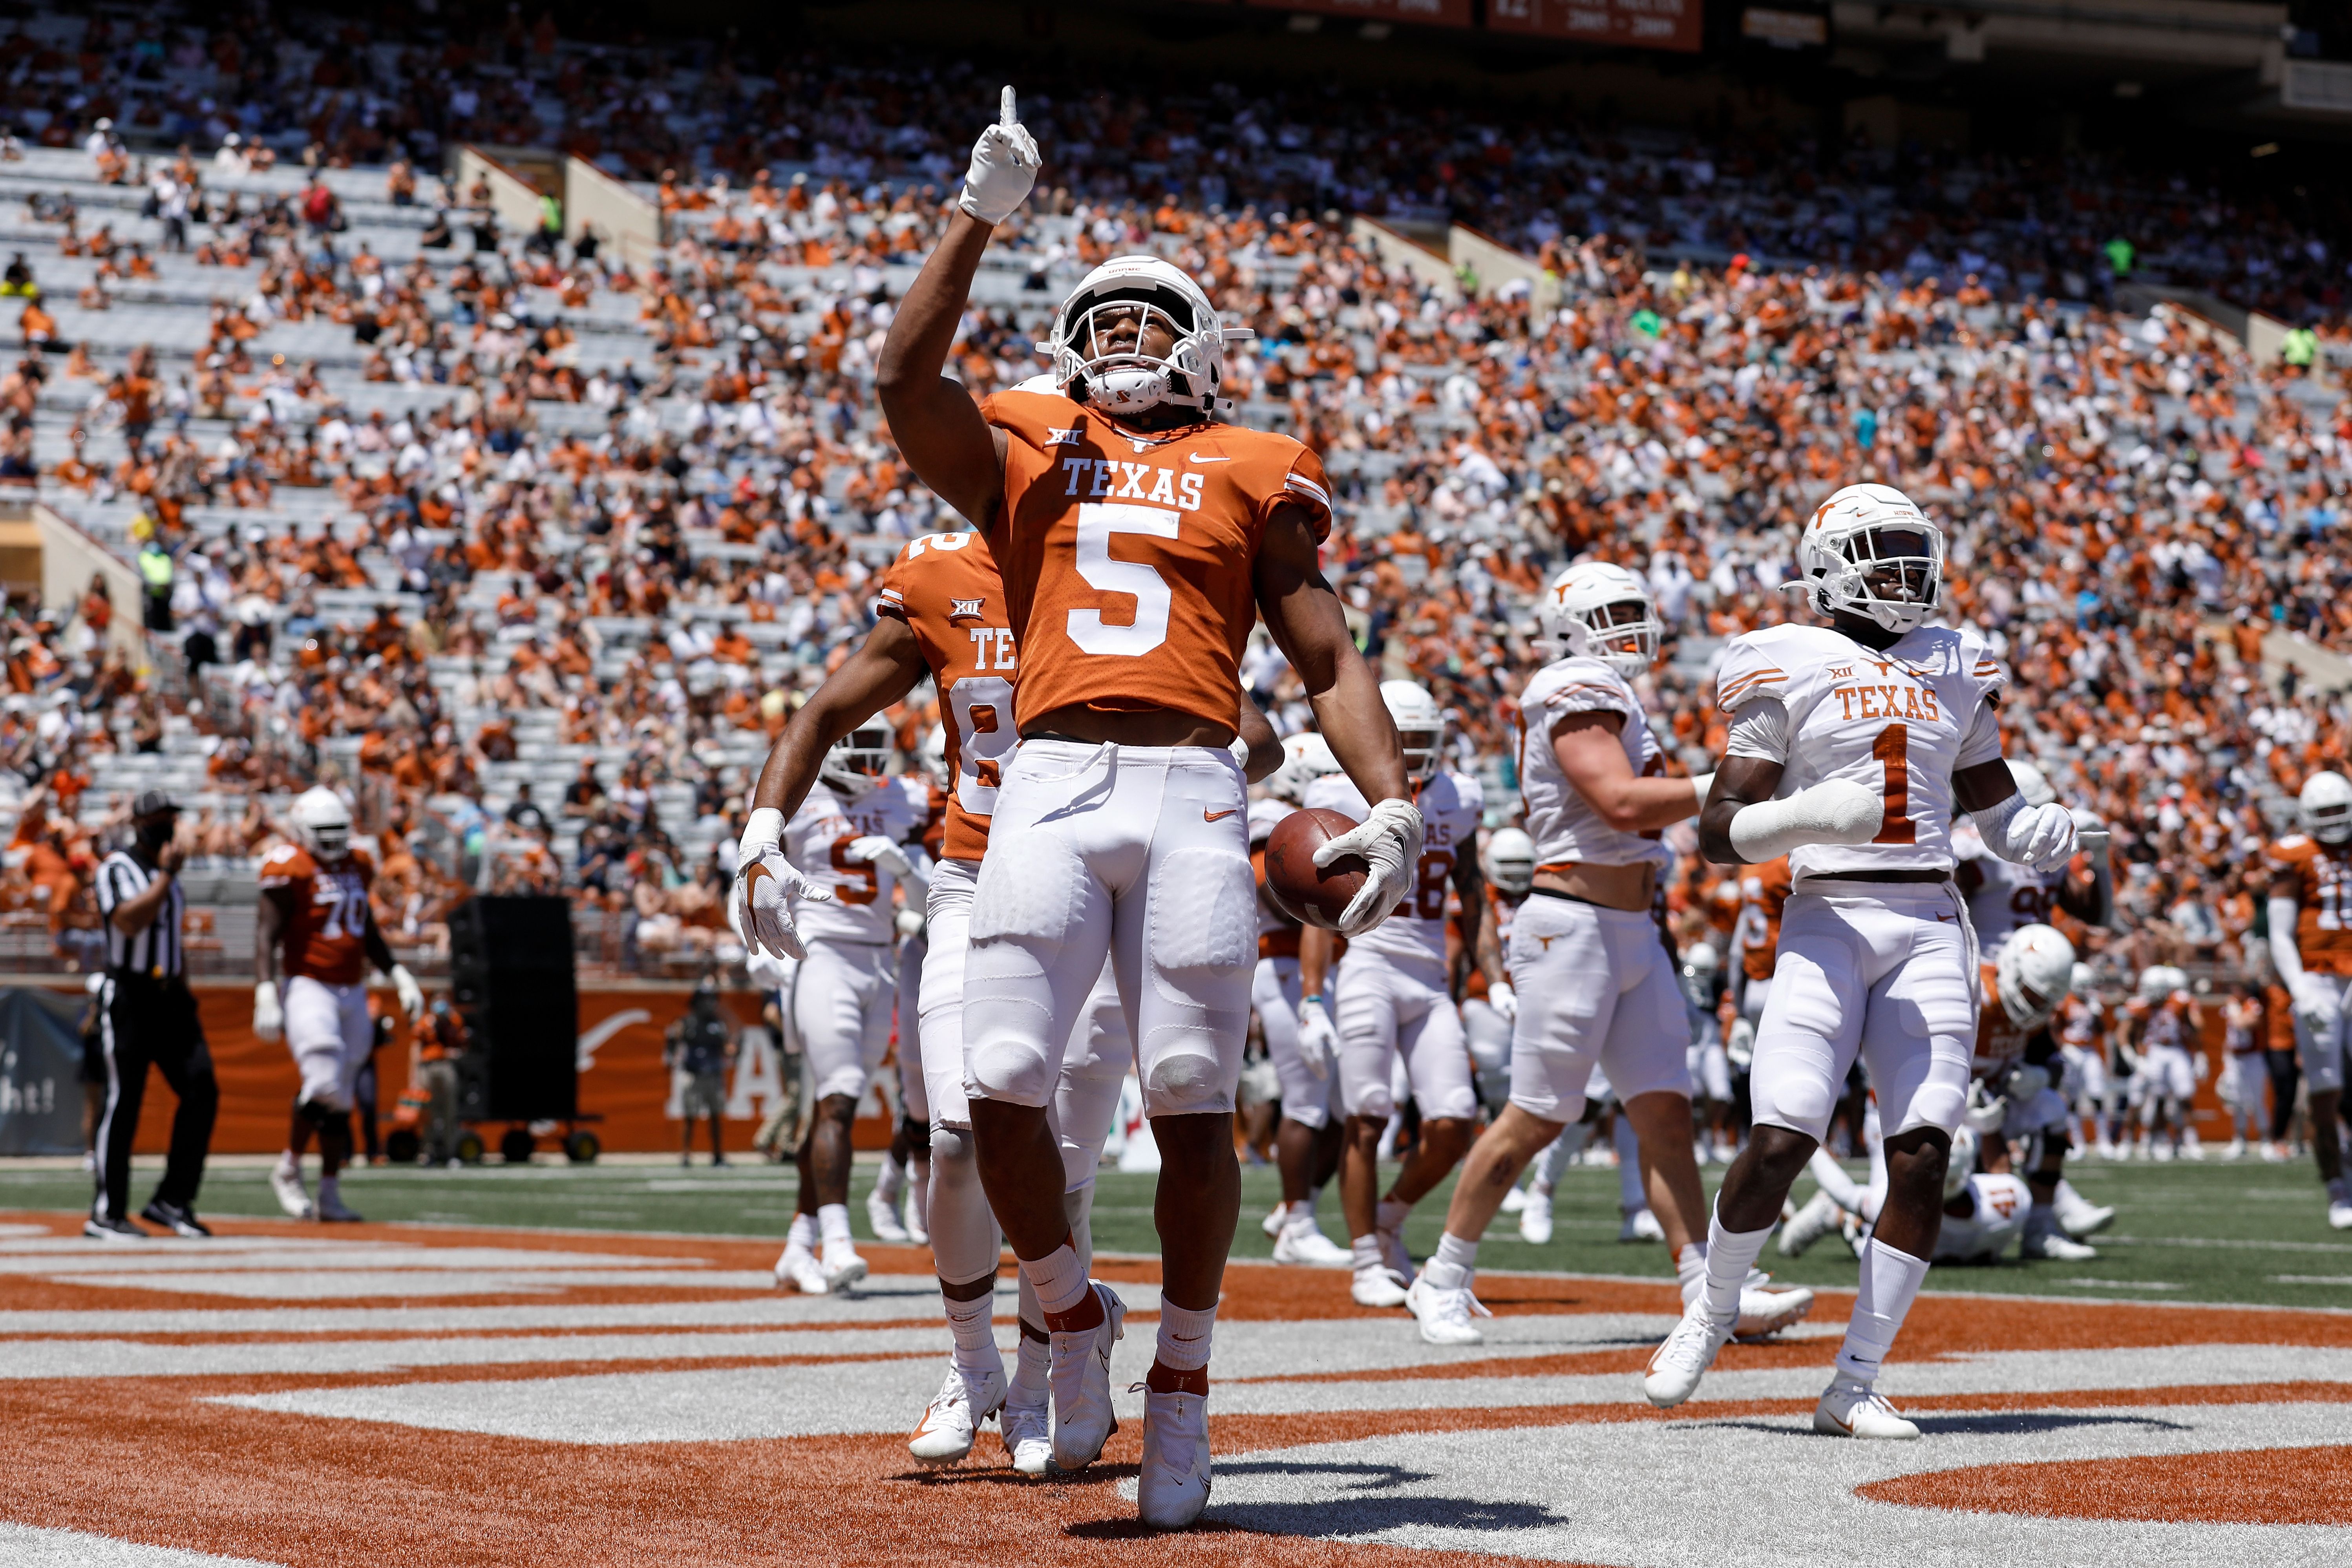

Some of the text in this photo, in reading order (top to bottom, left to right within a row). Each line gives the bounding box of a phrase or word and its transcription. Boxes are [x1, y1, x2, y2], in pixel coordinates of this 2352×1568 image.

[1045, 427, 1083, 446] XII
[1062, 457, 1204, 511] TEXAS
[1066, 503, 1181, 657] 5
[950, 599, 985, 618] XII
[970, 628, 1018, 670] TE
[1828, 665, 1857, 679] XII
[1834, 685, 1939, 722] TEXAS
[1873, 724, 1916, 844] 1
[1392, 850, 1456, 919] 8
[313, 887, 368, 940] 70
[1989, 1187, 2017, 1220] 41
